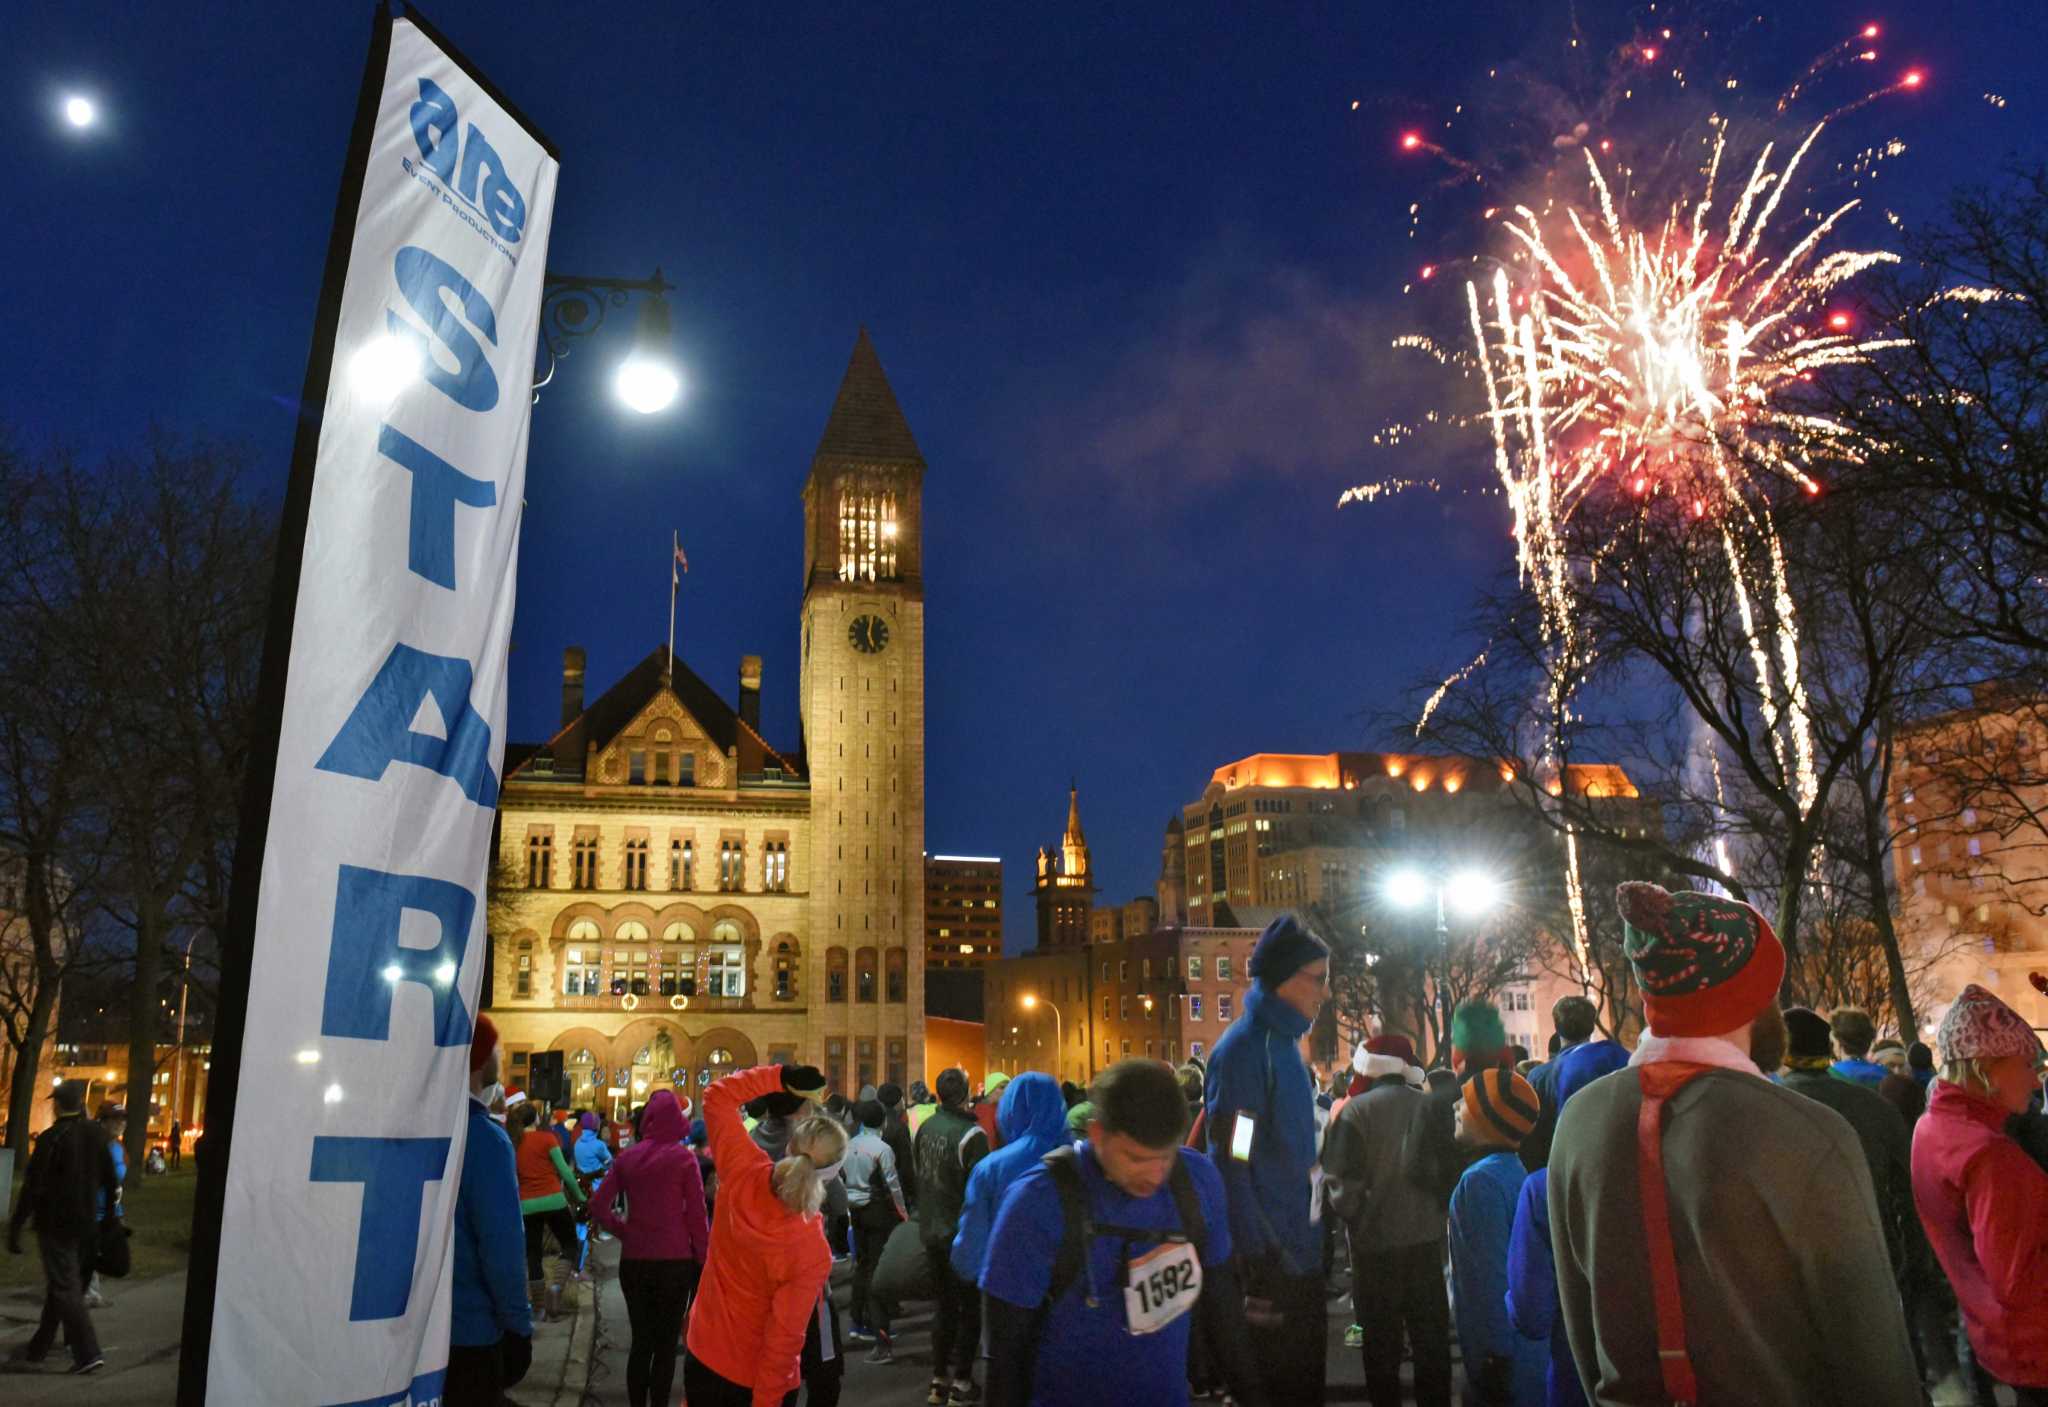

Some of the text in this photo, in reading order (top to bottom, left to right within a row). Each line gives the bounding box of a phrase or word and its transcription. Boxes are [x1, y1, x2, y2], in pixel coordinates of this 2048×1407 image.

[402, 156, 517, 267] EVENT PRODUCTIONS
[309, 246, 500, 1322] START
[1135, 1259, 1197, 1314] 1592
